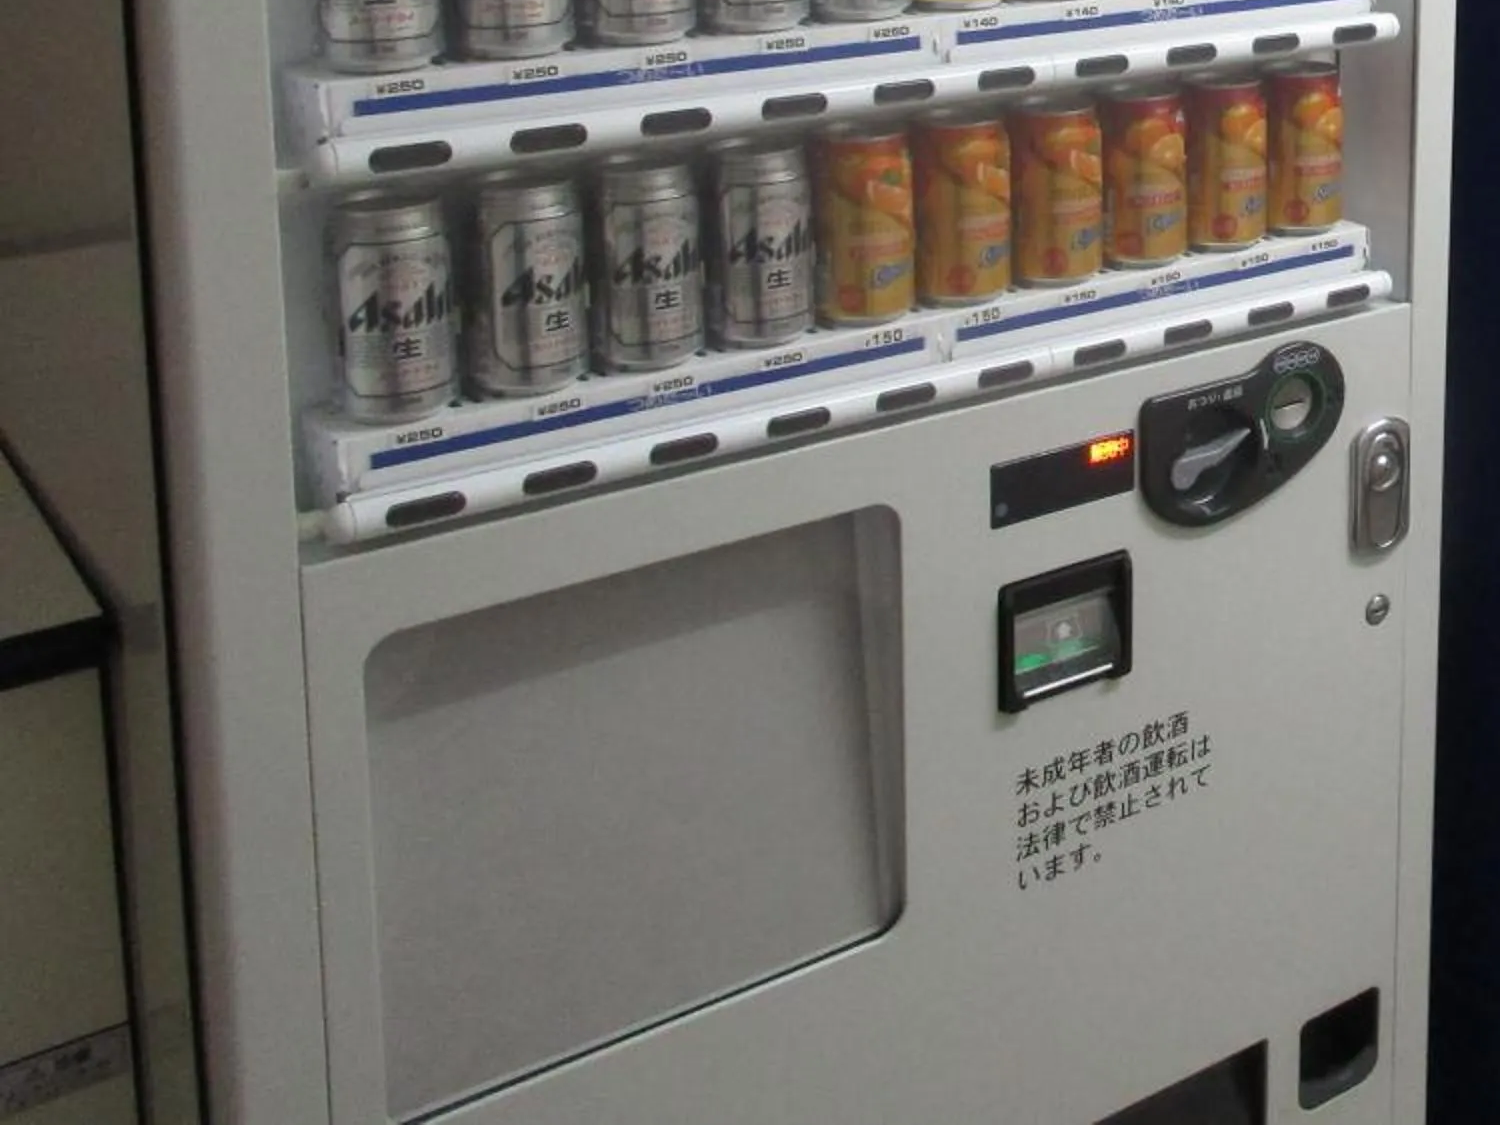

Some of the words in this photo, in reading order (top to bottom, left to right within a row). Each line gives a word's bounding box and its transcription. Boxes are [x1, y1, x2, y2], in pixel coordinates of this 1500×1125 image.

[767, 269, 791, 289] 生
[655, 290, 680, 311] 生
[545, 311, 570, 332] 生
[394, 338, 422, 360] 生
[1016, 710, 1189, 796] 未成年者の飲酒
[1017, 735, 1211, 827] および飲酒運転は
[1016, 763, 1211, 862] 法律で禁止されて
[1018, 843, 1101, 890] います。
